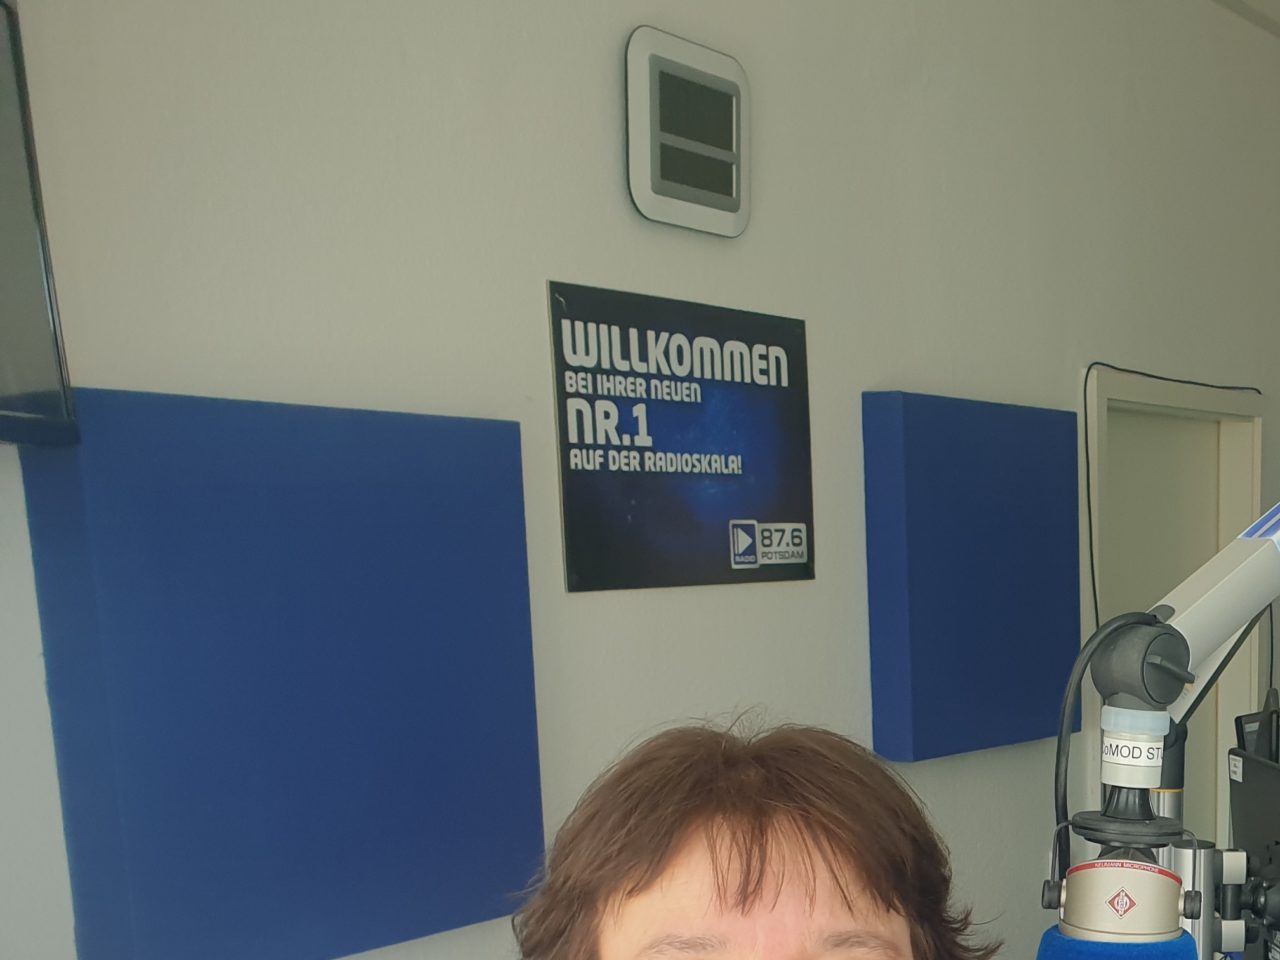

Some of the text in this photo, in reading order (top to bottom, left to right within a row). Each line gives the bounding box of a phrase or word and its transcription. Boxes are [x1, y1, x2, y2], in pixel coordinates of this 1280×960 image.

[561, 319, 788, 388] WILLKOMMEN
[565, 372, 702, 403] BEI IHRER NEUEN
[567, 398, 652, 447] NR.1
[570, 448, 743, 474] AUF DER RADIOSKALA!
[760, 528, 803, 548] 87.6
[761, 549, 805, 561] POTSDAM
[1103, 743, 1142, 759] oMOD
